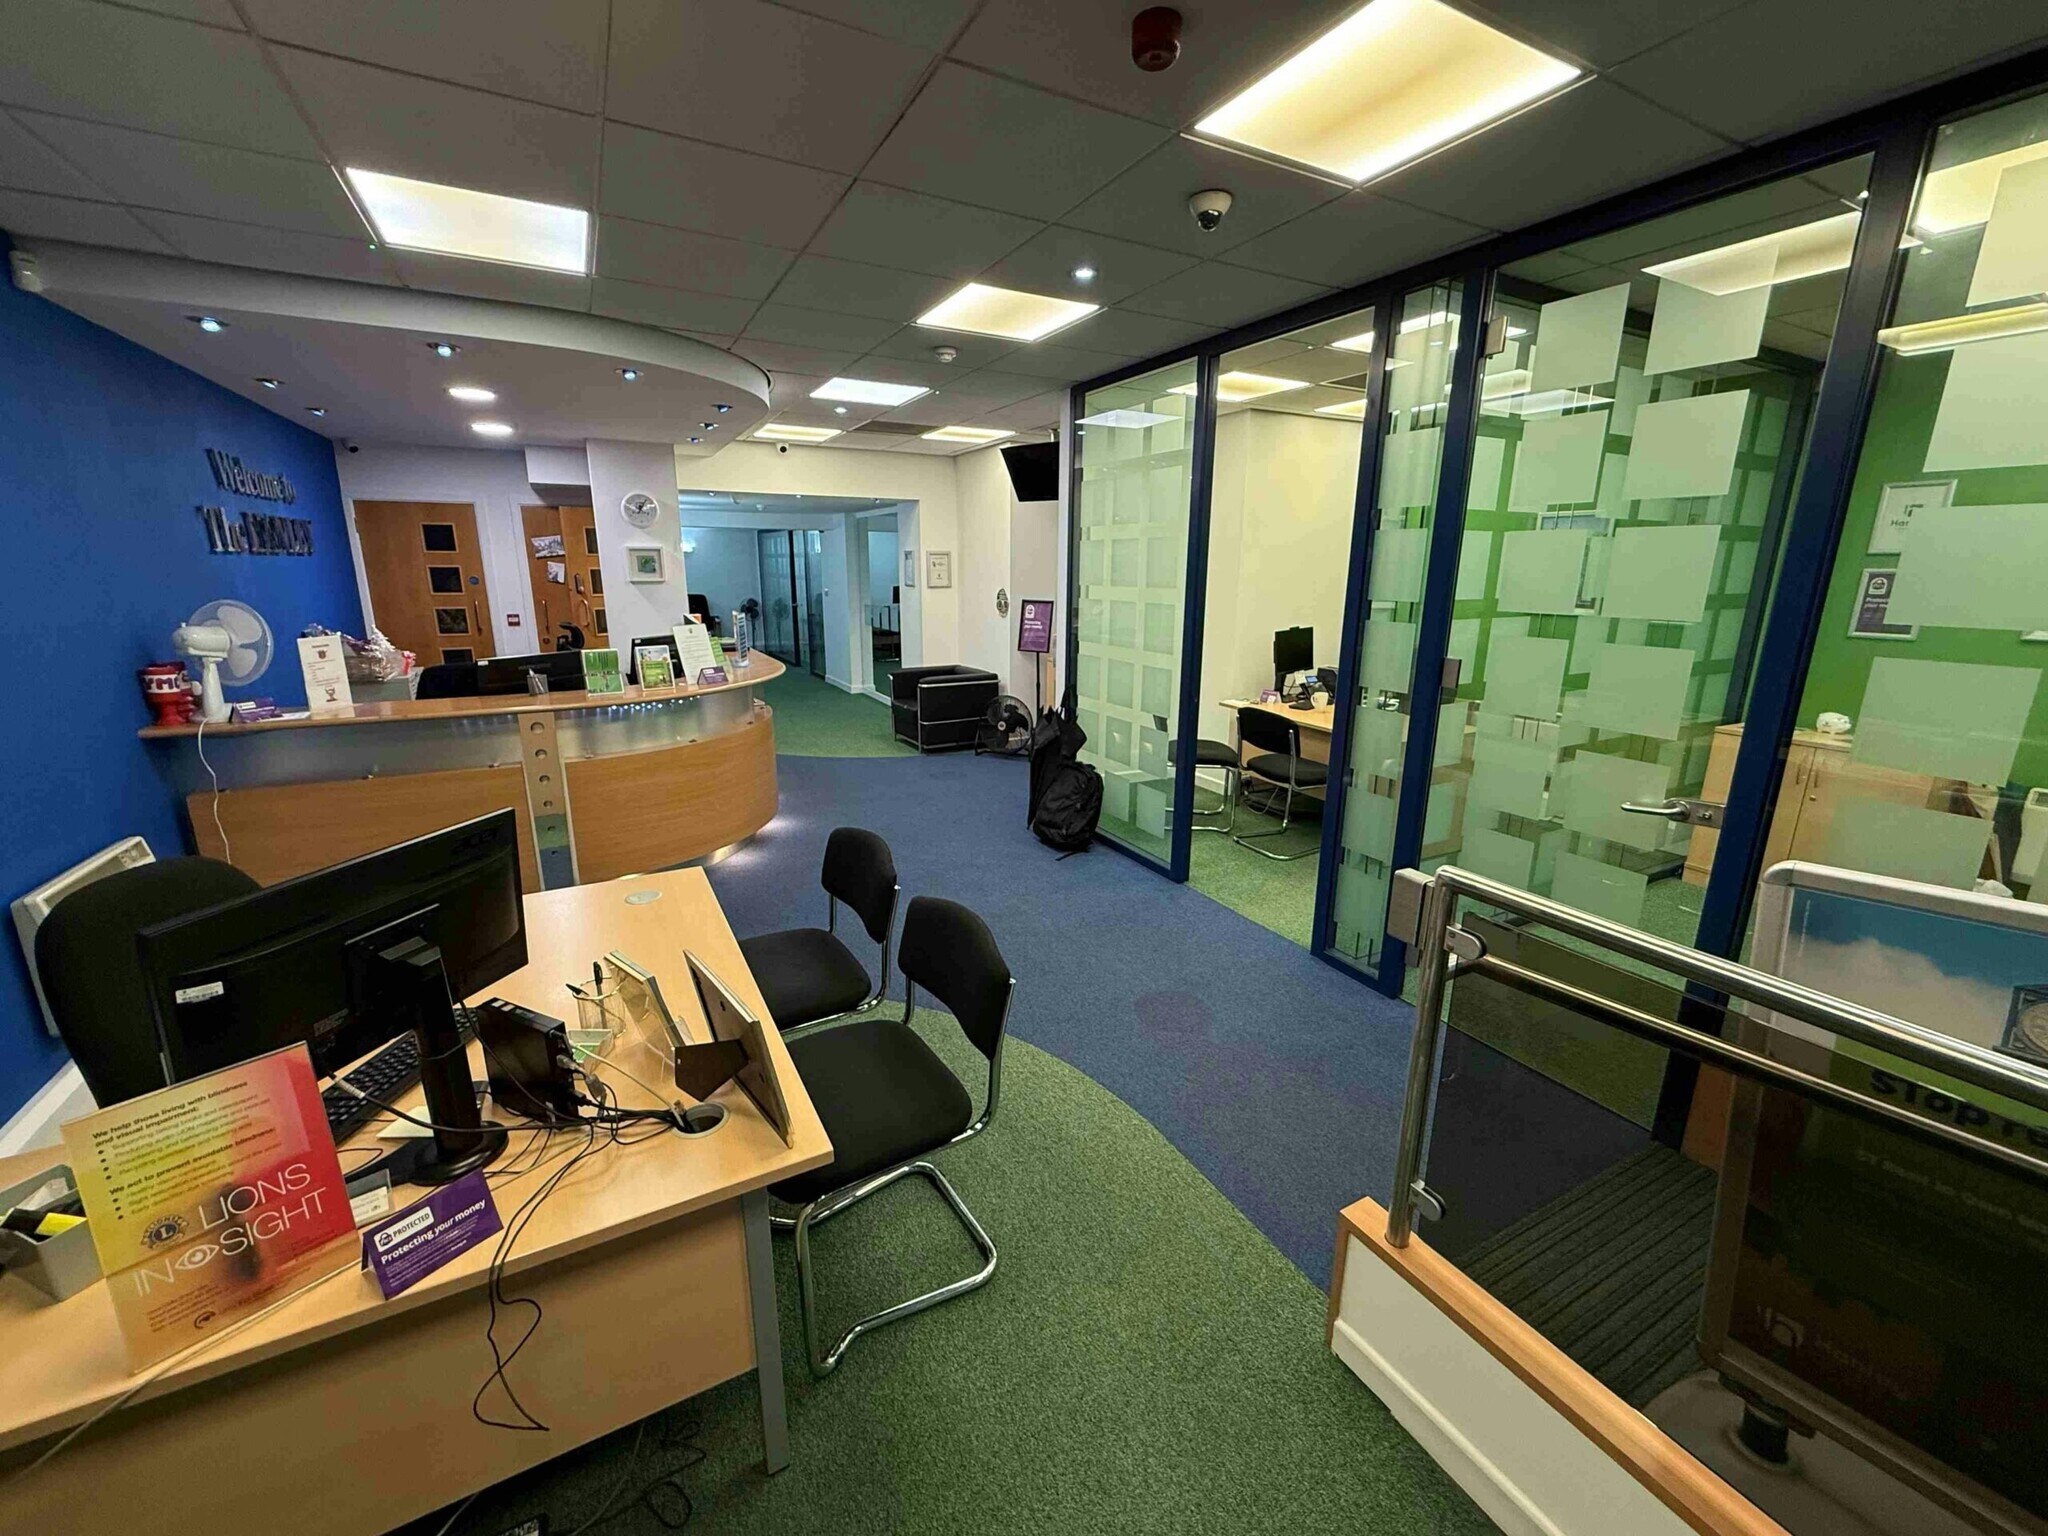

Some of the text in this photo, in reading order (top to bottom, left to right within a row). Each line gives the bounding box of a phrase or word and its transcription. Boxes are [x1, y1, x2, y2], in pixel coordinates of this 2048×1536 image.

[204, 448, 285, 502] Welcome
[194, 505, 248, 555] The
[92, 1081, 247, 1139] We help those living with blindness
[95, 1136, 114, 1147] and
[116, 1126, 143, 1139] visual
[109, 1184, 125, 1195] We
[127, 1179, 142, 1188] act
[156, 1160, 191, 1177] prevent
[192, 1144, 234, 1162] avoidable
[198, 1163, 311, 1231] LIONS
[133, 1258, 175, 1297] IN
[219, 1187, 327, 1256] SIGHT
[380, 1229, 435, 1265] Protecting
[433, 1217, 455, 1239] your
[454, 1199, 486, 1222] money
[392, 1212, 430, 1238] PROTECTED
